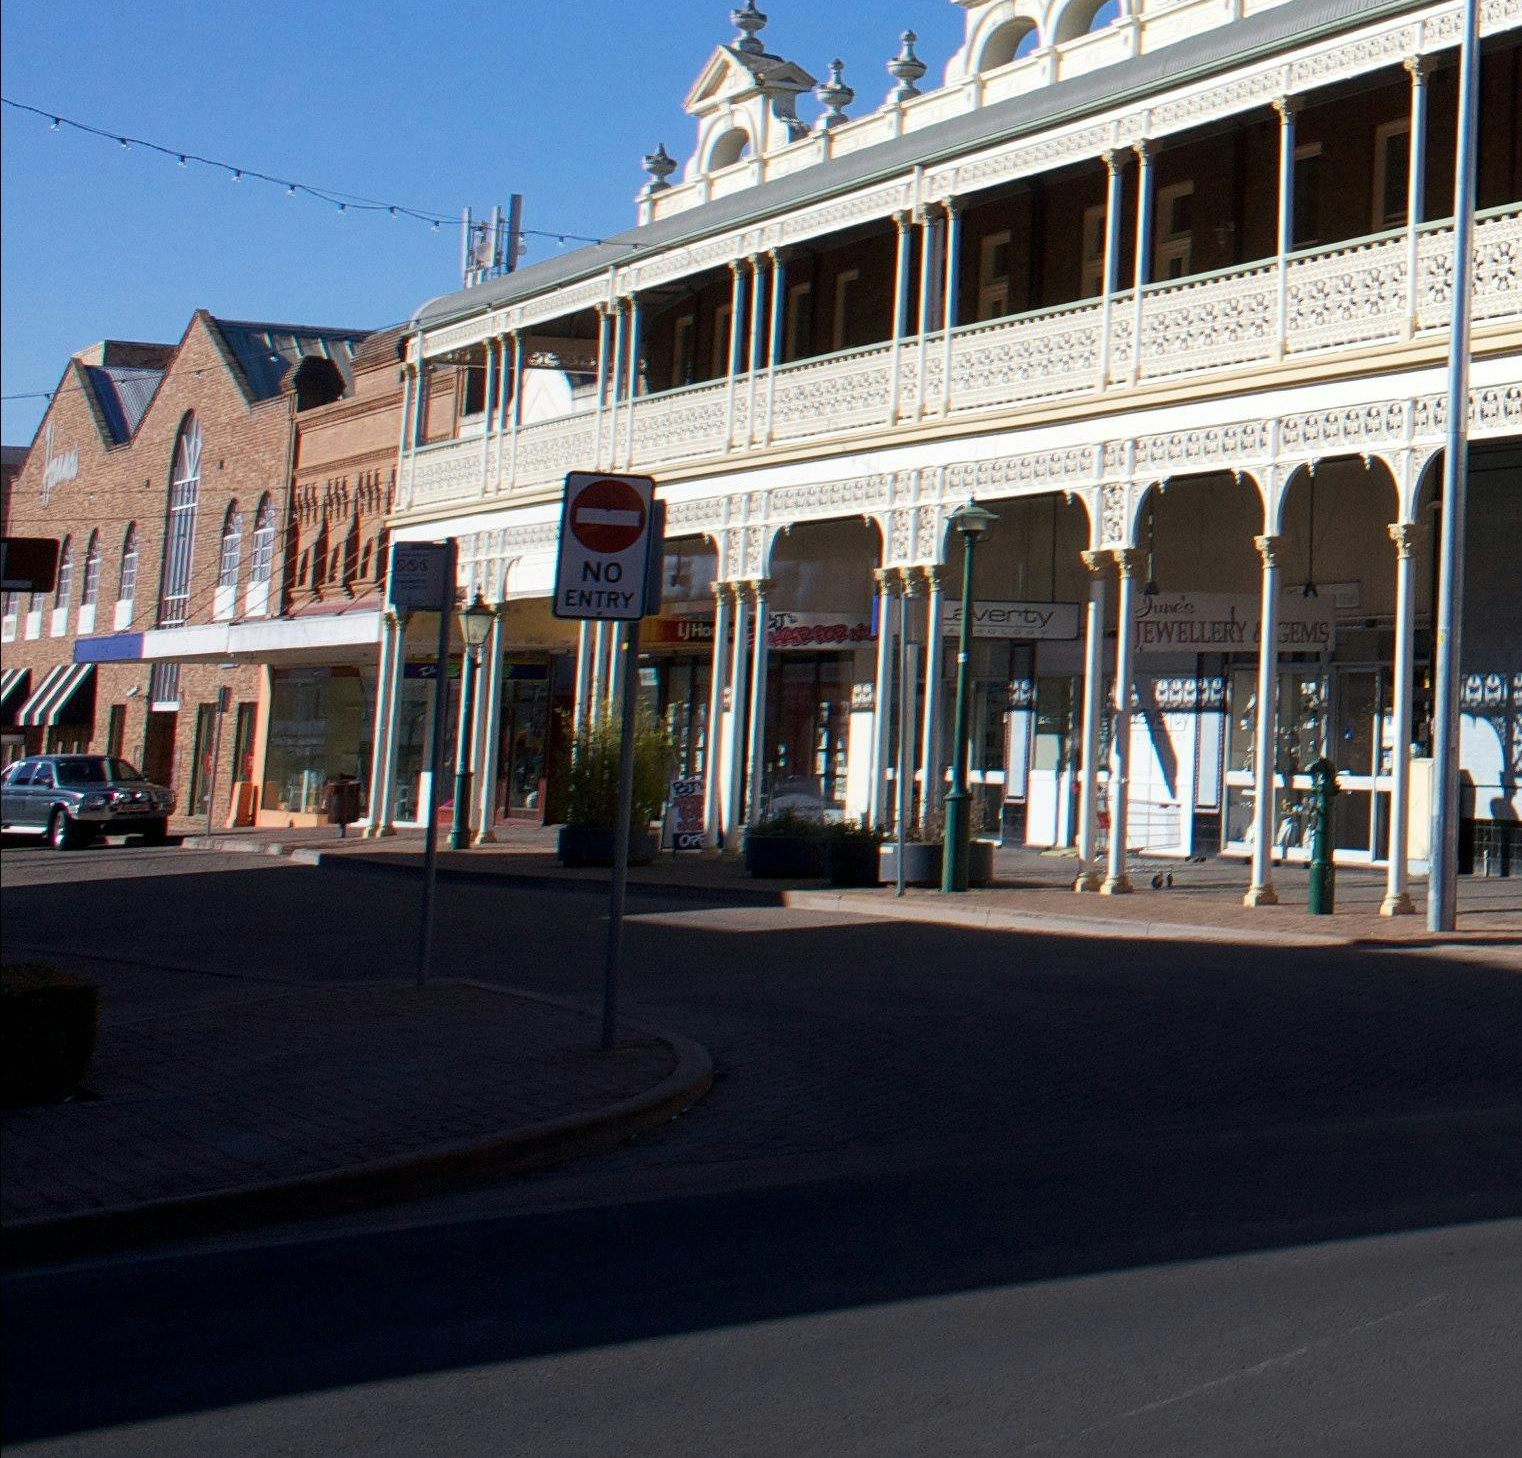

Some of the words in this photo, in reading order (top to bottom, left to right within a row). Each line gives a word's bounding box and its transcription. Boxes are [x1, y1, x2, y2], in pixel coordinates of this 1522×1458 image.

[582, 561, 622, 583] NO
[564, 589, 634, 609] ENTRY
[1134, 593, 1196, 618] June's
[1134, 620, 1248, 648] JEWELLERY
